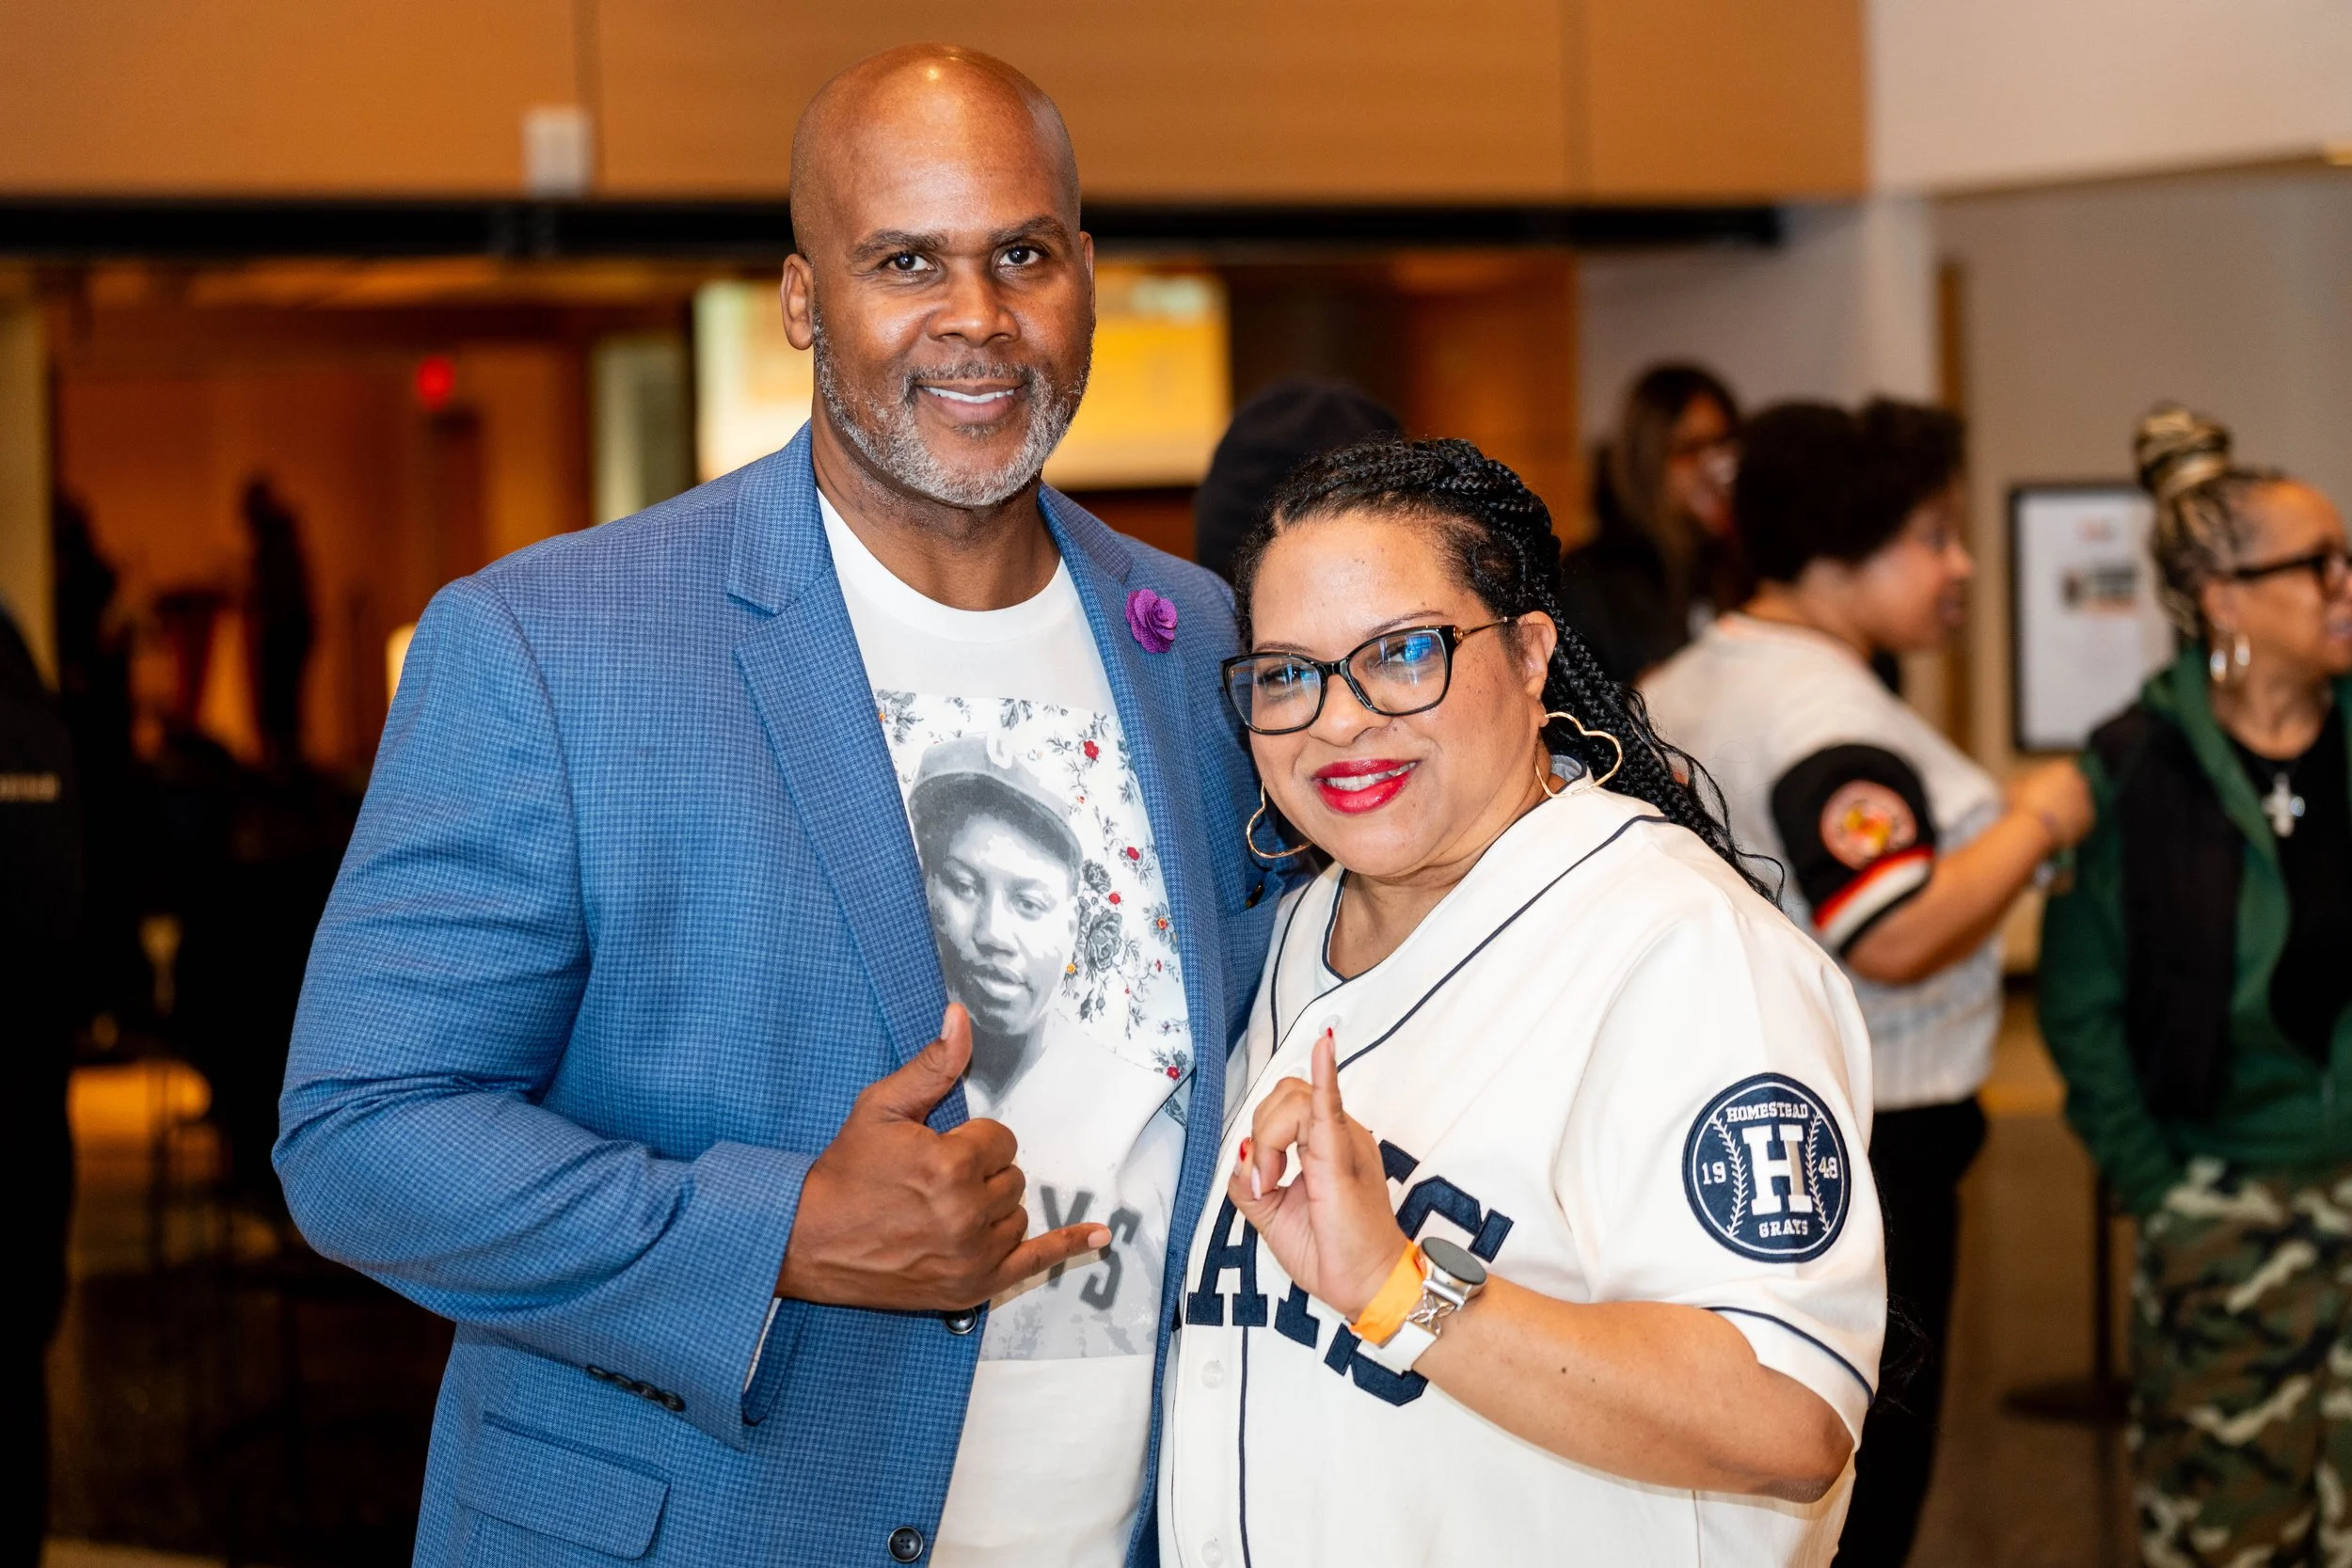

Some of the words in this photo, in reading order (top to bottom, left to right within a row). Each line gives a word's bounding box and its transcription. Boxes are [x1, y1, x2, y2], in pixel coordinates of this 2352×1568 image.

[1725, 1101, 1808, 1123] HOMESTEAD
[1701, 1161, 1726, 1185] 19
[1741, 1124, 1813, 1216] H
[1758, 1218, 1808, 1239] GRAYS
